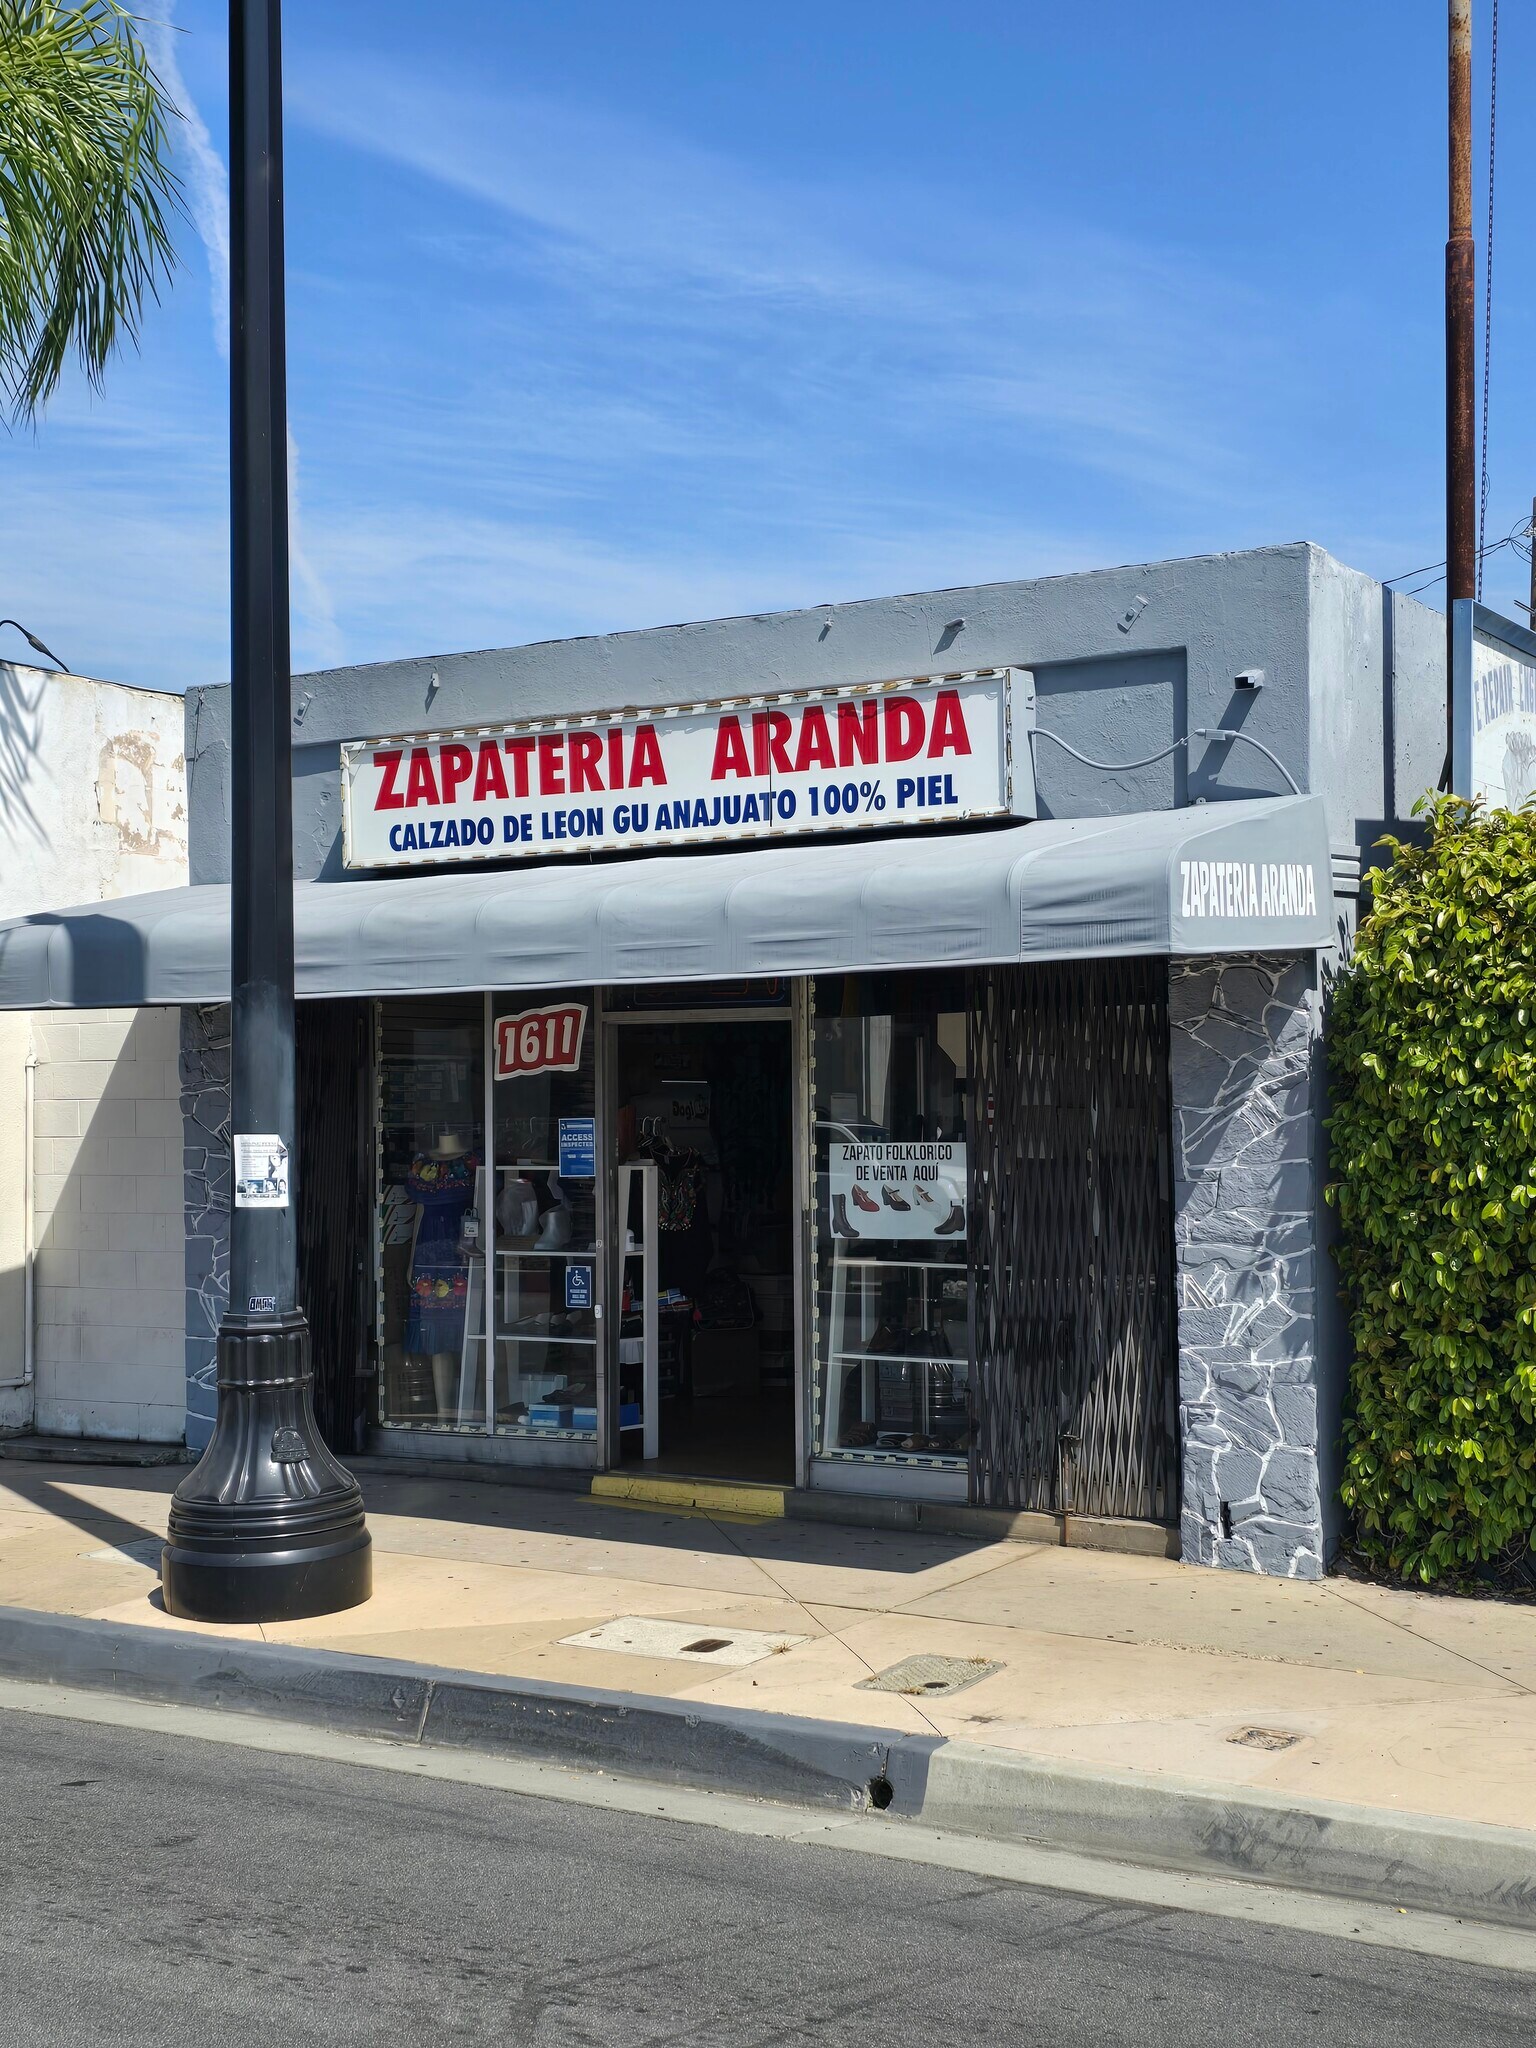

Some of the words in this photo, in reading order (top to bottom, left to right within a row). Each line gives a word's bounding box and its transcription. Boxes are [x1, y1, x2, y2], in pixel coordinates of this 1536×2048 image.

[1482, 664, 1514, 725] REPAIR
[373, 725, 668, 811] ZAPATERIA
[711, 689, 972, 781] ARANDA
[389, 817, 494, 852] CALZADO
[503, 814, 534, 843] DE
[541, 808, 604, 840] LEON
[808, 781, 886, 816] 100%
[896, 774, 958, 809] PIEL
[1180, 861, 1259, 918] ZAPATERIA
[1261, 863, 1317, 917] ARANDA
[505, 1015, 574, 1066] 1611
[561, 1133, 593, 1142] ACCESS
[842, 1144, 883, 1161] ZAPATO
[885, 1144, 953, 1161] FOLKLORICO
[856, 1165, 870, 1181] DE
[872, 1165, 908, 1181] VENTA
[912, 1162, 939, 1182] AQUÍ
